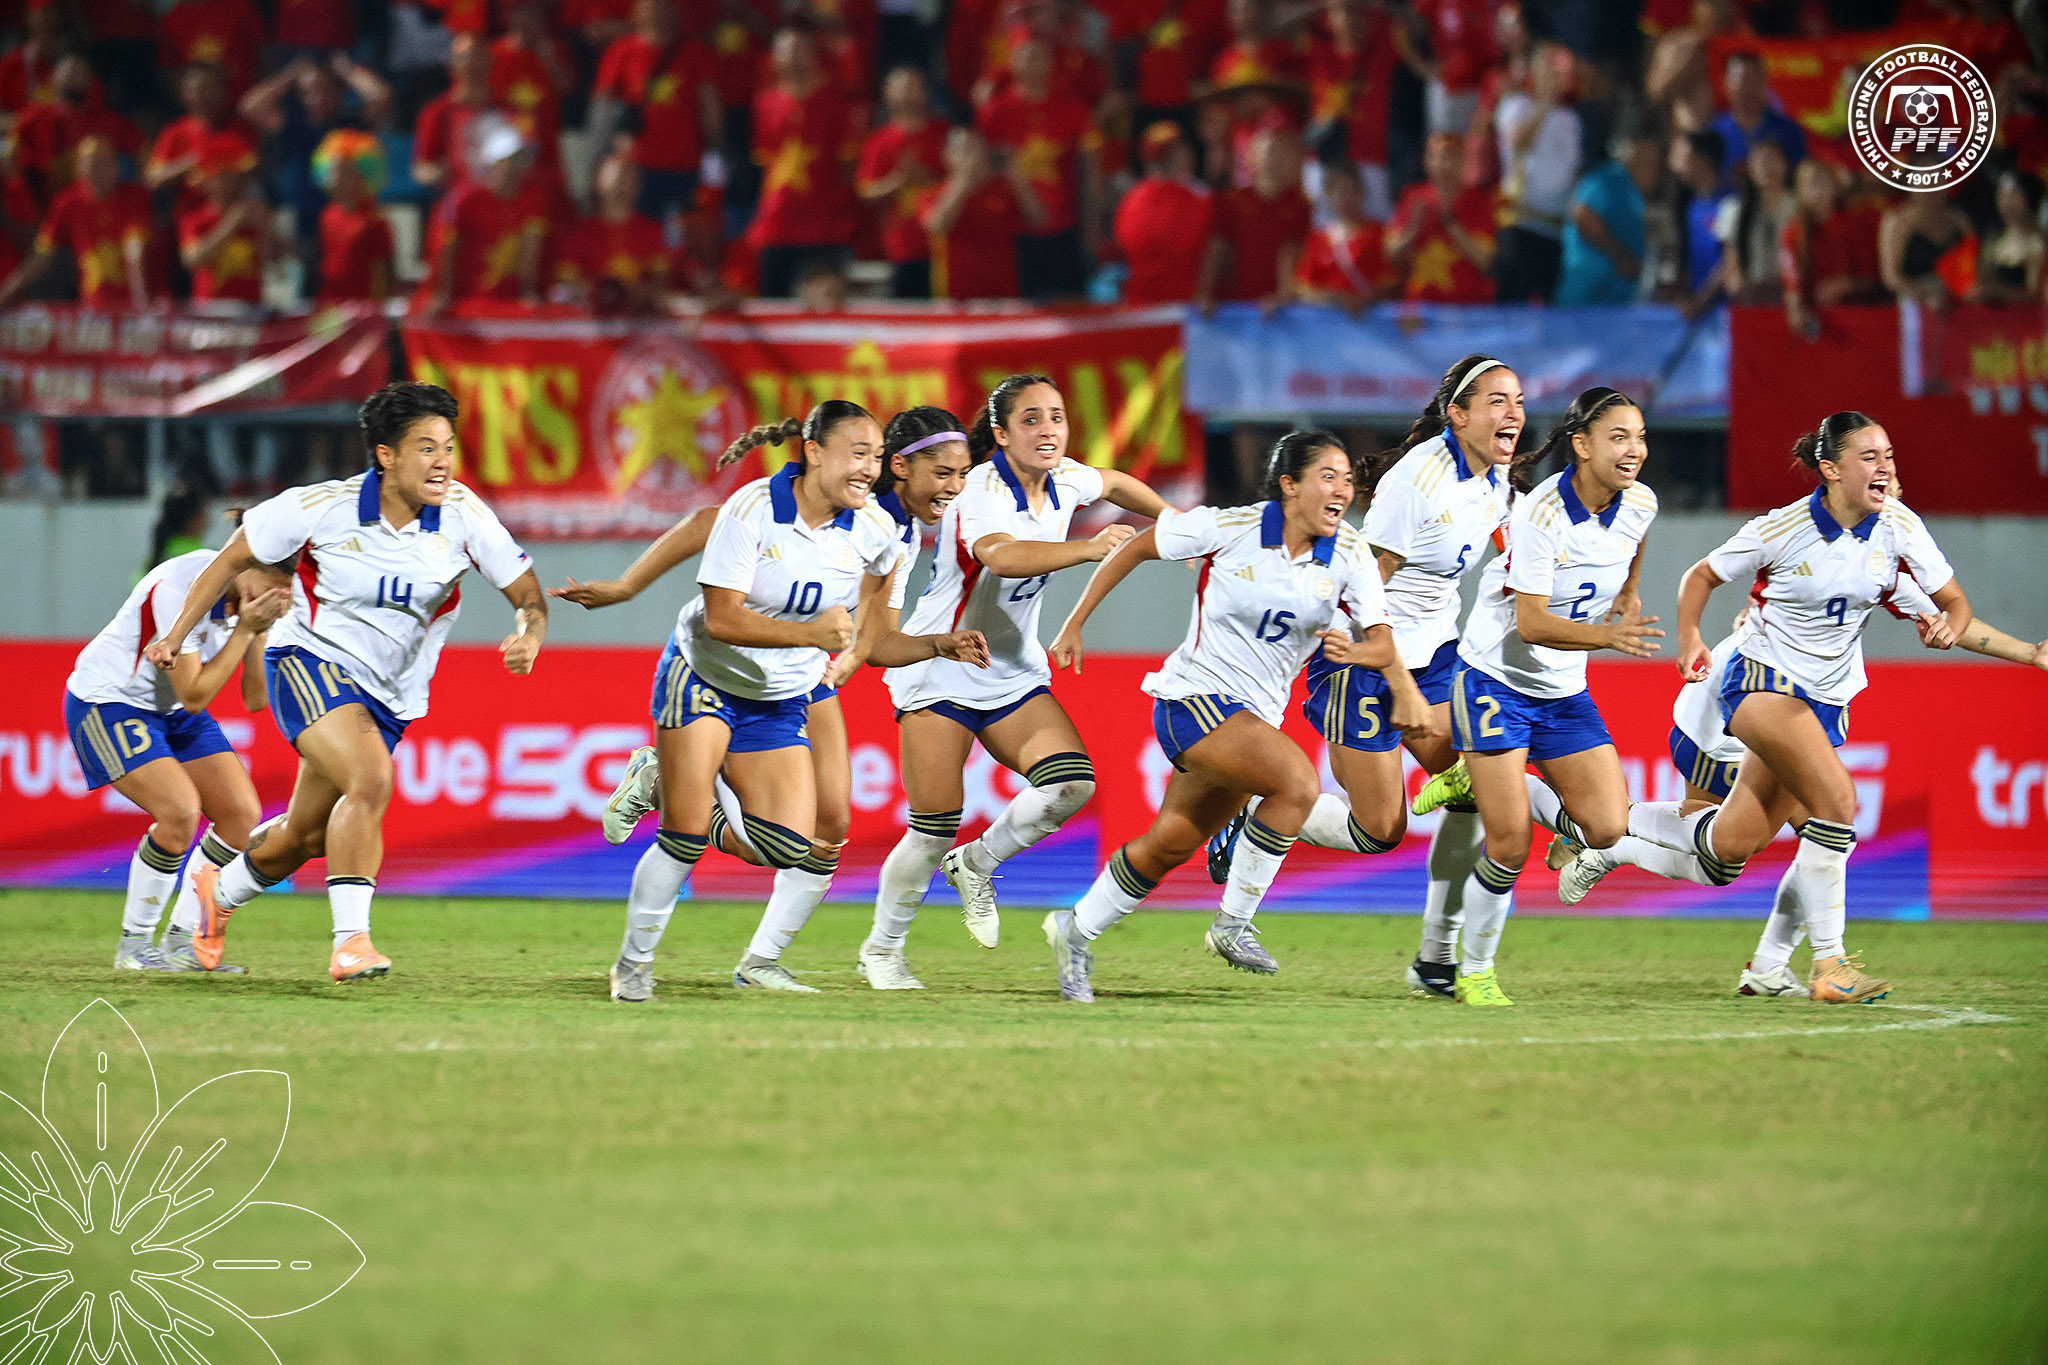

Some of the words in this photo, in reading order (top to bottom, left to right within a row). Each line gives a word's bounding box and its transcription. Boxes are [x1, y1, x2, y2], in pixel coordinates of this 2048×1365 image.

[1446, 544, 1472, 577] 5
[377, 575, 413, 608] 14
[782, 580, 823, 615] 10
[1570, 582, 1597, 619] 2
[1256, 608, 1297, 643] 15
[1826, 597, 1847, 626] 9
[1358, 696, 1381, 739] 5
[1475, 695, 1504, 738] 2
[113, 718, 152, 759] 13
[490, 722, 650, 821] 5G
